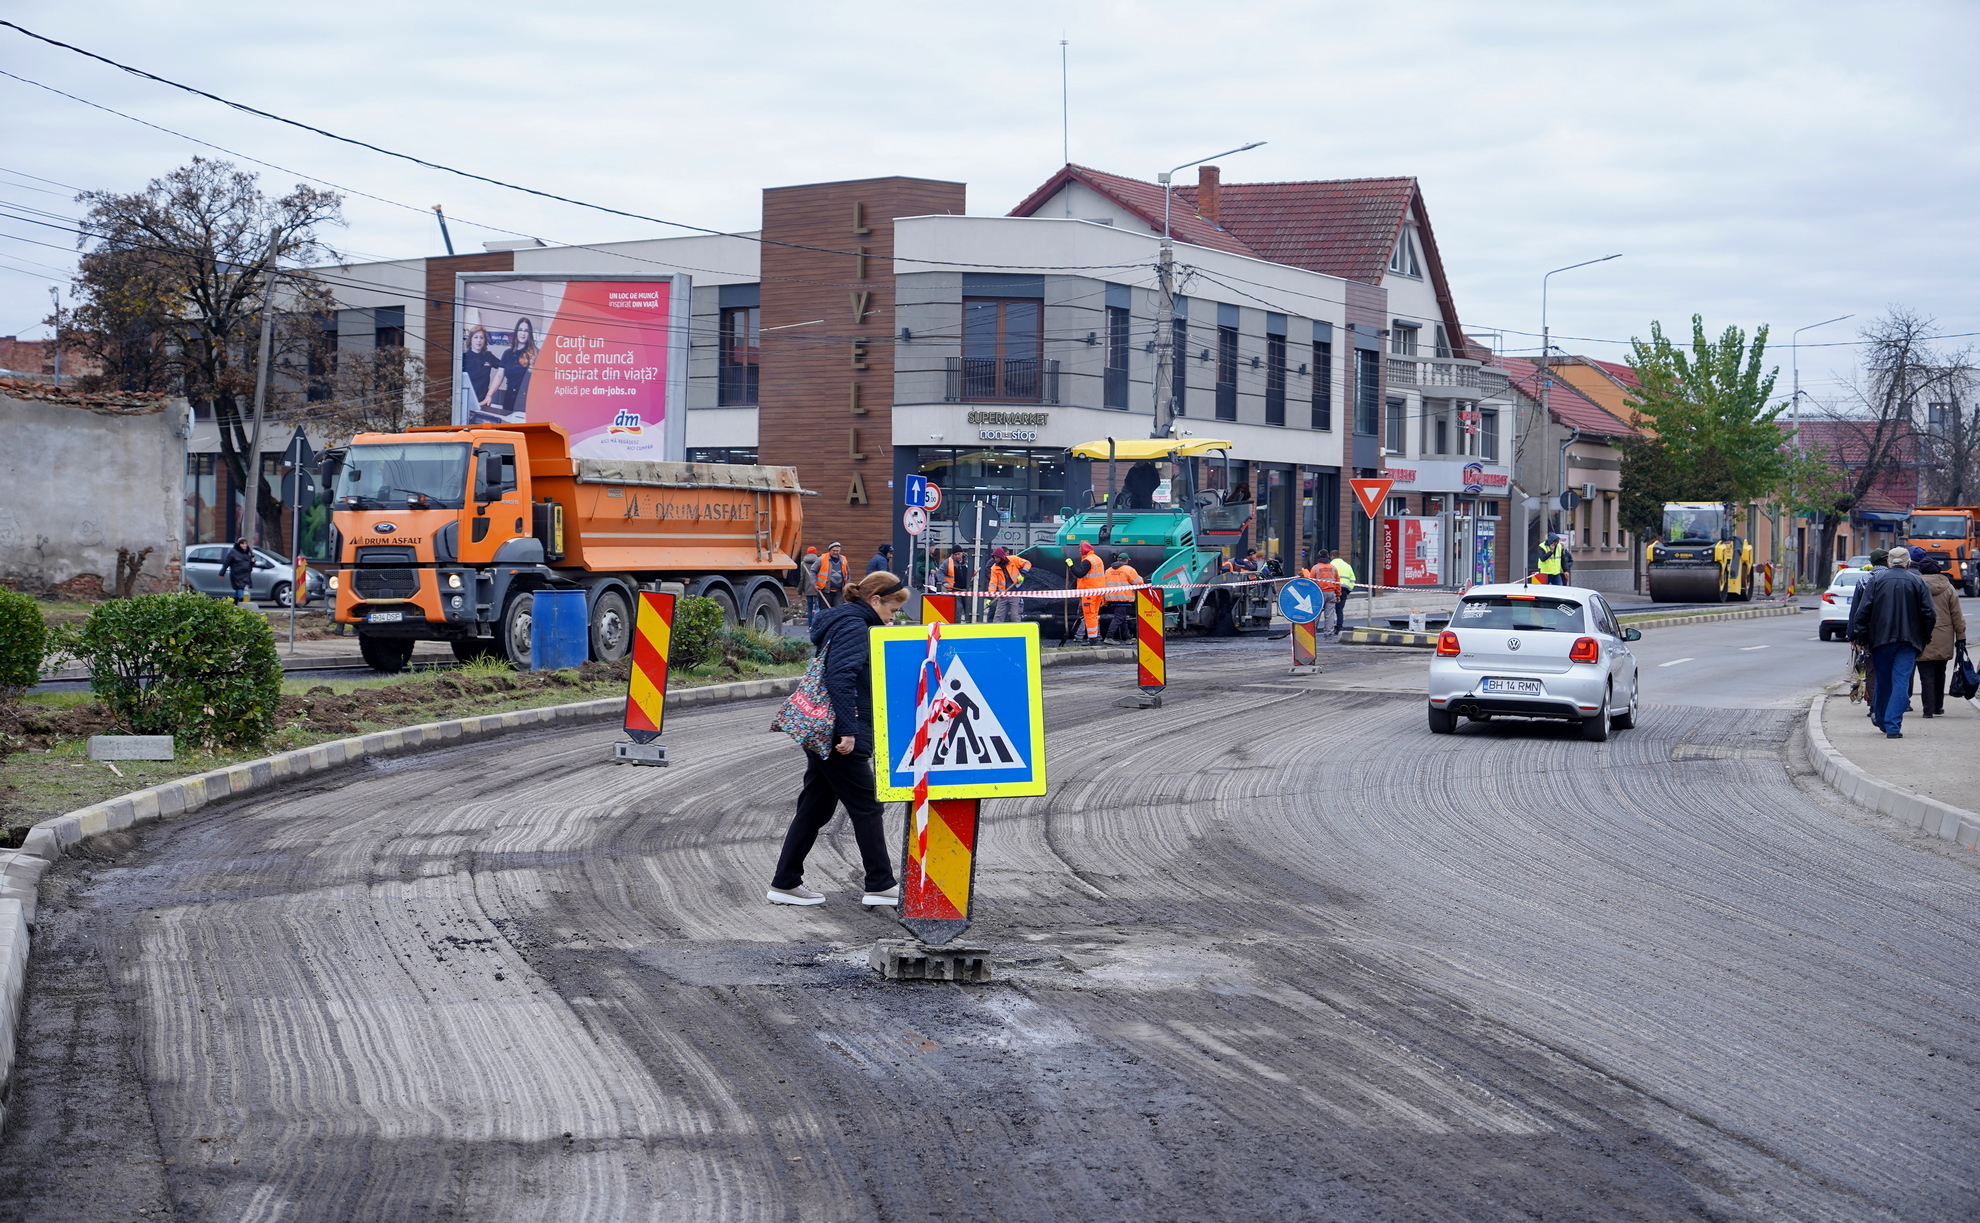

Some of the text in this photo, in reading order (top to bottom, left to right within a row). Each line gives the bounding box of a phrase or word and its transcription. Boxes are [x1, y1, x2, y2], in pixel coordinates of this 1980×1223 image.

[609, 300, 631, 308] inspirat
[555, 335, 604, 351] Cauți un
[555, 351, 634, 364] loc de muncă
[846, 202, 871, 505] LIVELLA
[554, 367, 658, 383] inspirat din viață?
[554, 386, 637, 396] Aplică pe dm-jobs.ro
[615, 410, 639, 426] dm
[968, 411, 1049, 425] SUPERMARKET
[656, 502, 751, 520] DRUM ASFALT
[1384, 530, 1393, 570] easybox
[1489, 681, 1539, 691] BH 14 RMN
